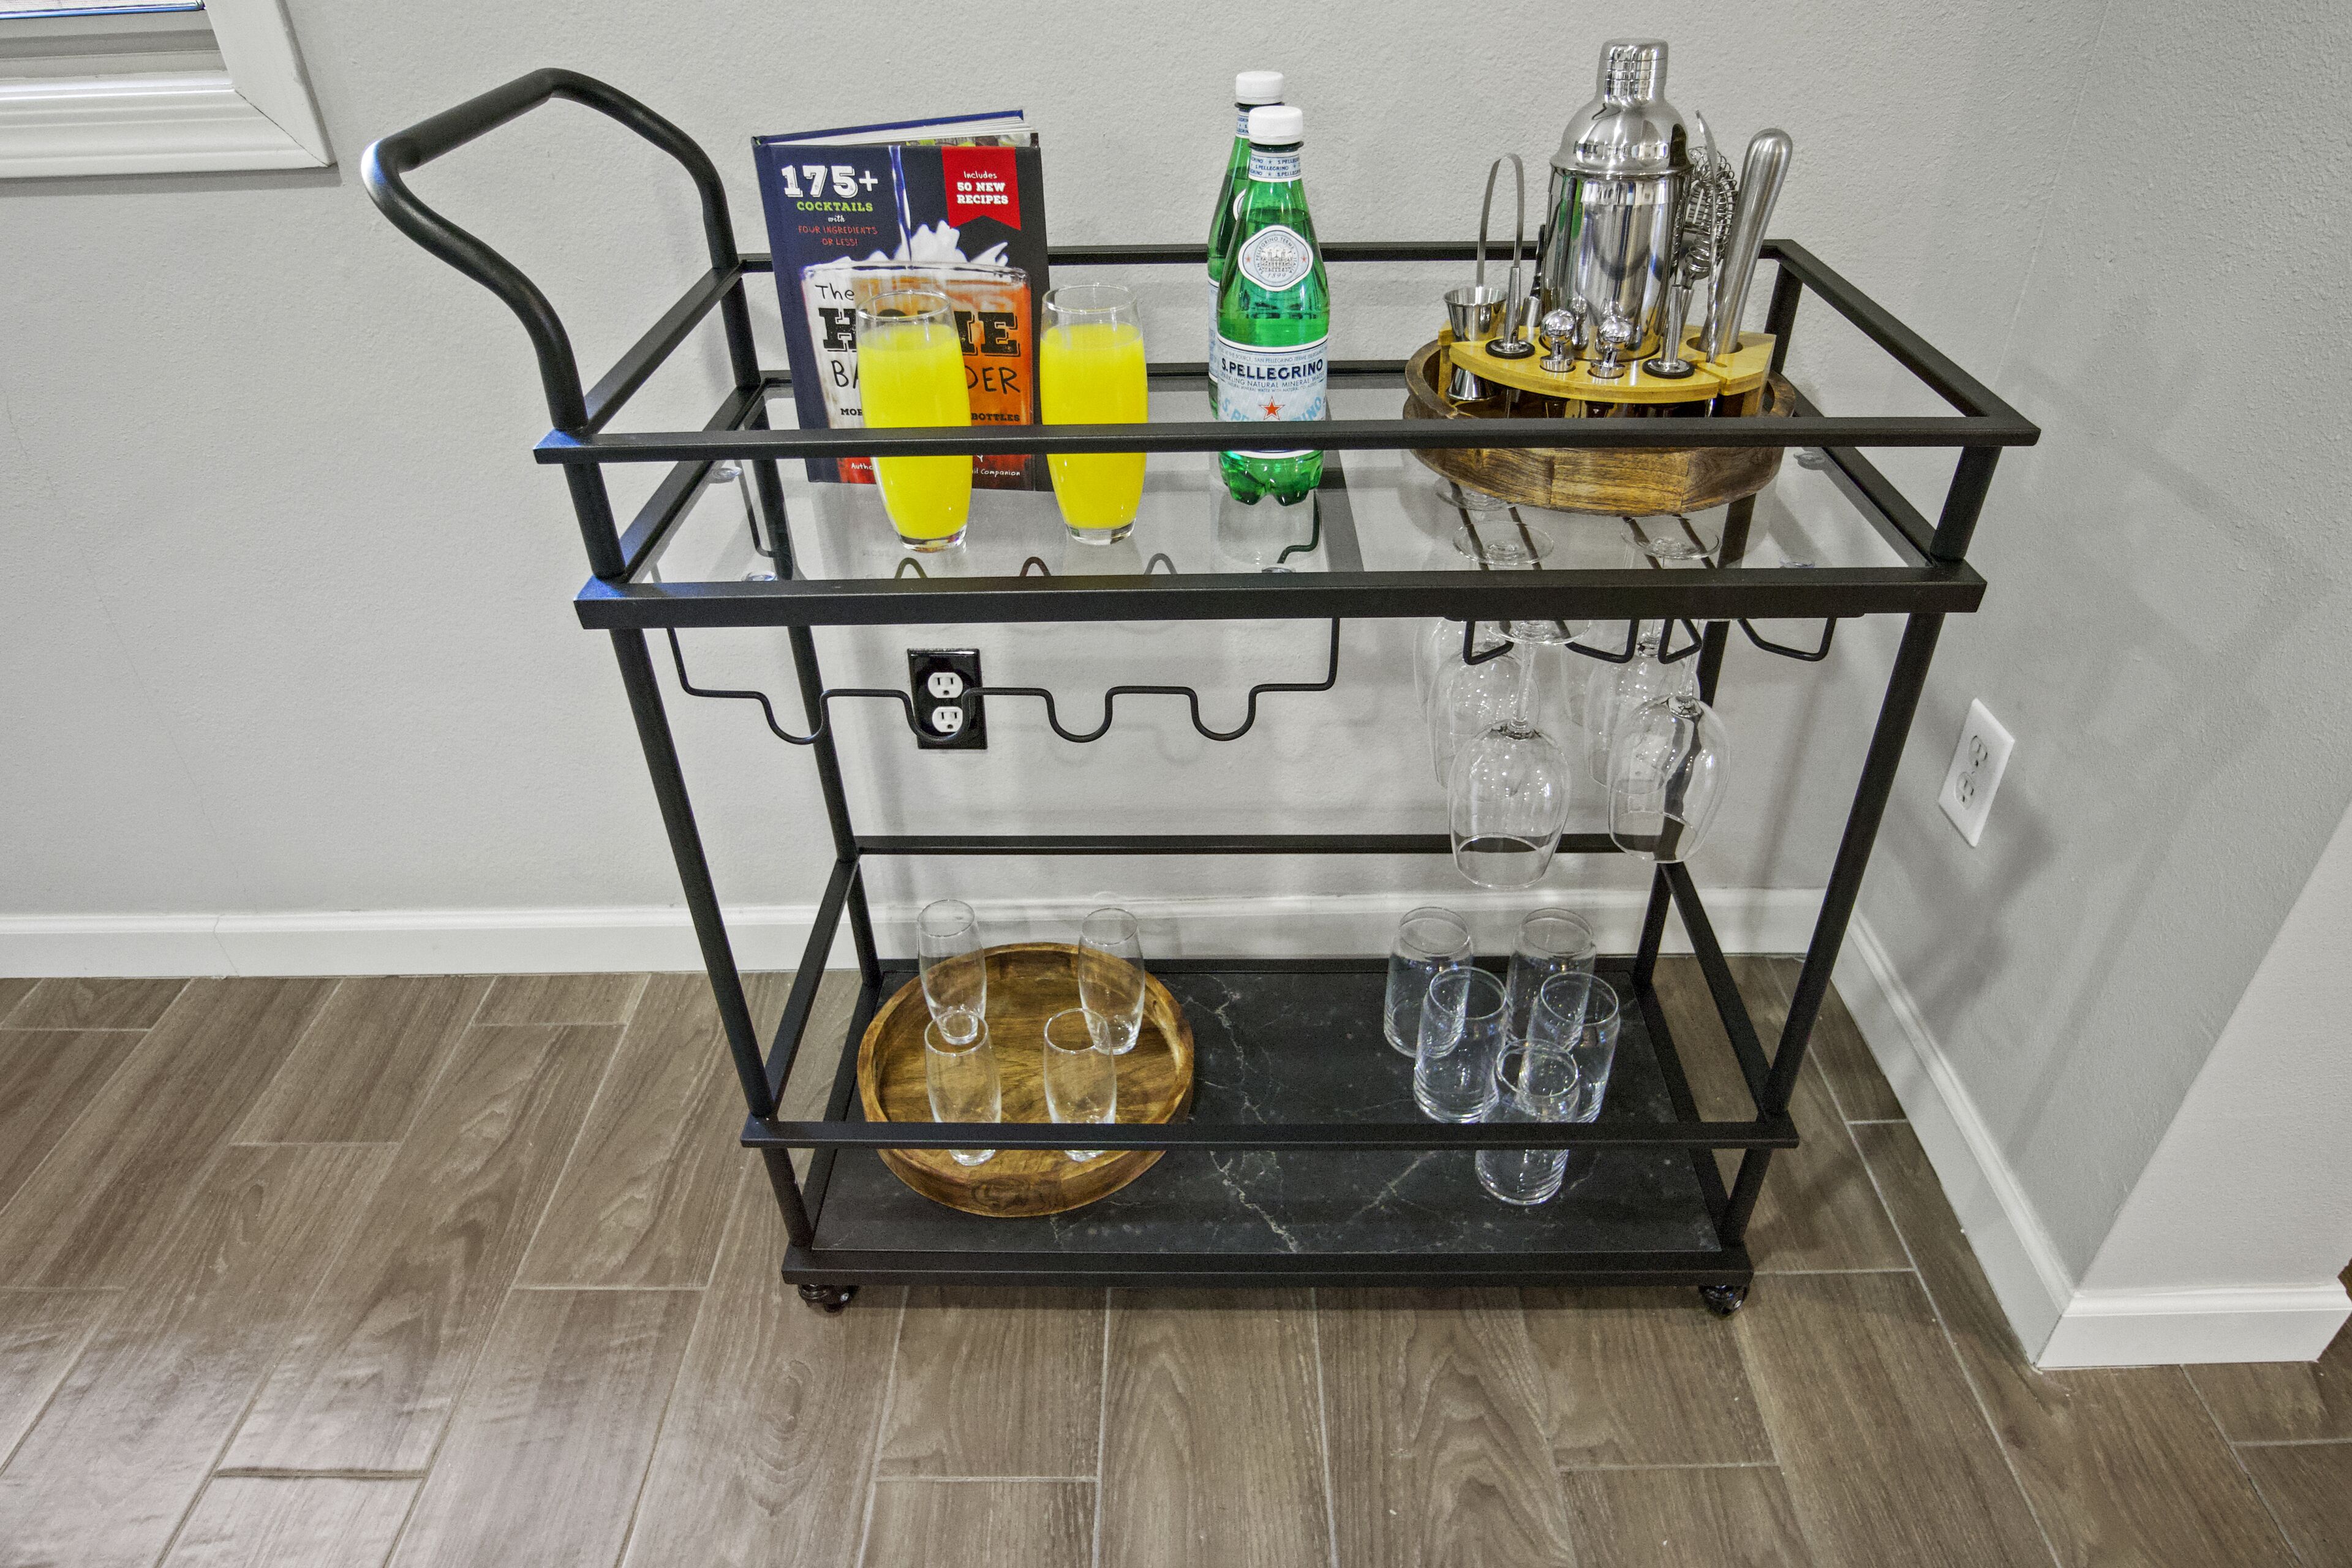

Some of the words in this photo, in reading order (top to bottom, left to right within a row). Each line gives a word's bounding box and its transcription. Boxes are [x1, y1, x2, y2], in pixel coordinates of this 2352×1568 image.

[963, 170, 997, 179] Includes
[782, 165, 878, 198] 175+
[957, 181, 973, 192] 50
[976, 182, 1006, 192] NEW
[957, 194, 1009, 205] RECIPES
[796, 201, 873, 212] COCKTAILS
[798, 225, 821, 234] FOUR
[823, 225, 878, 235] INGREDIENTS
[815, 282, 854, 301] The
[1281, 378, 1310, 388] MINERAL
[971, 413, 1020, 422] BOTTLES
[981, 469, 1020, 478] Companion
